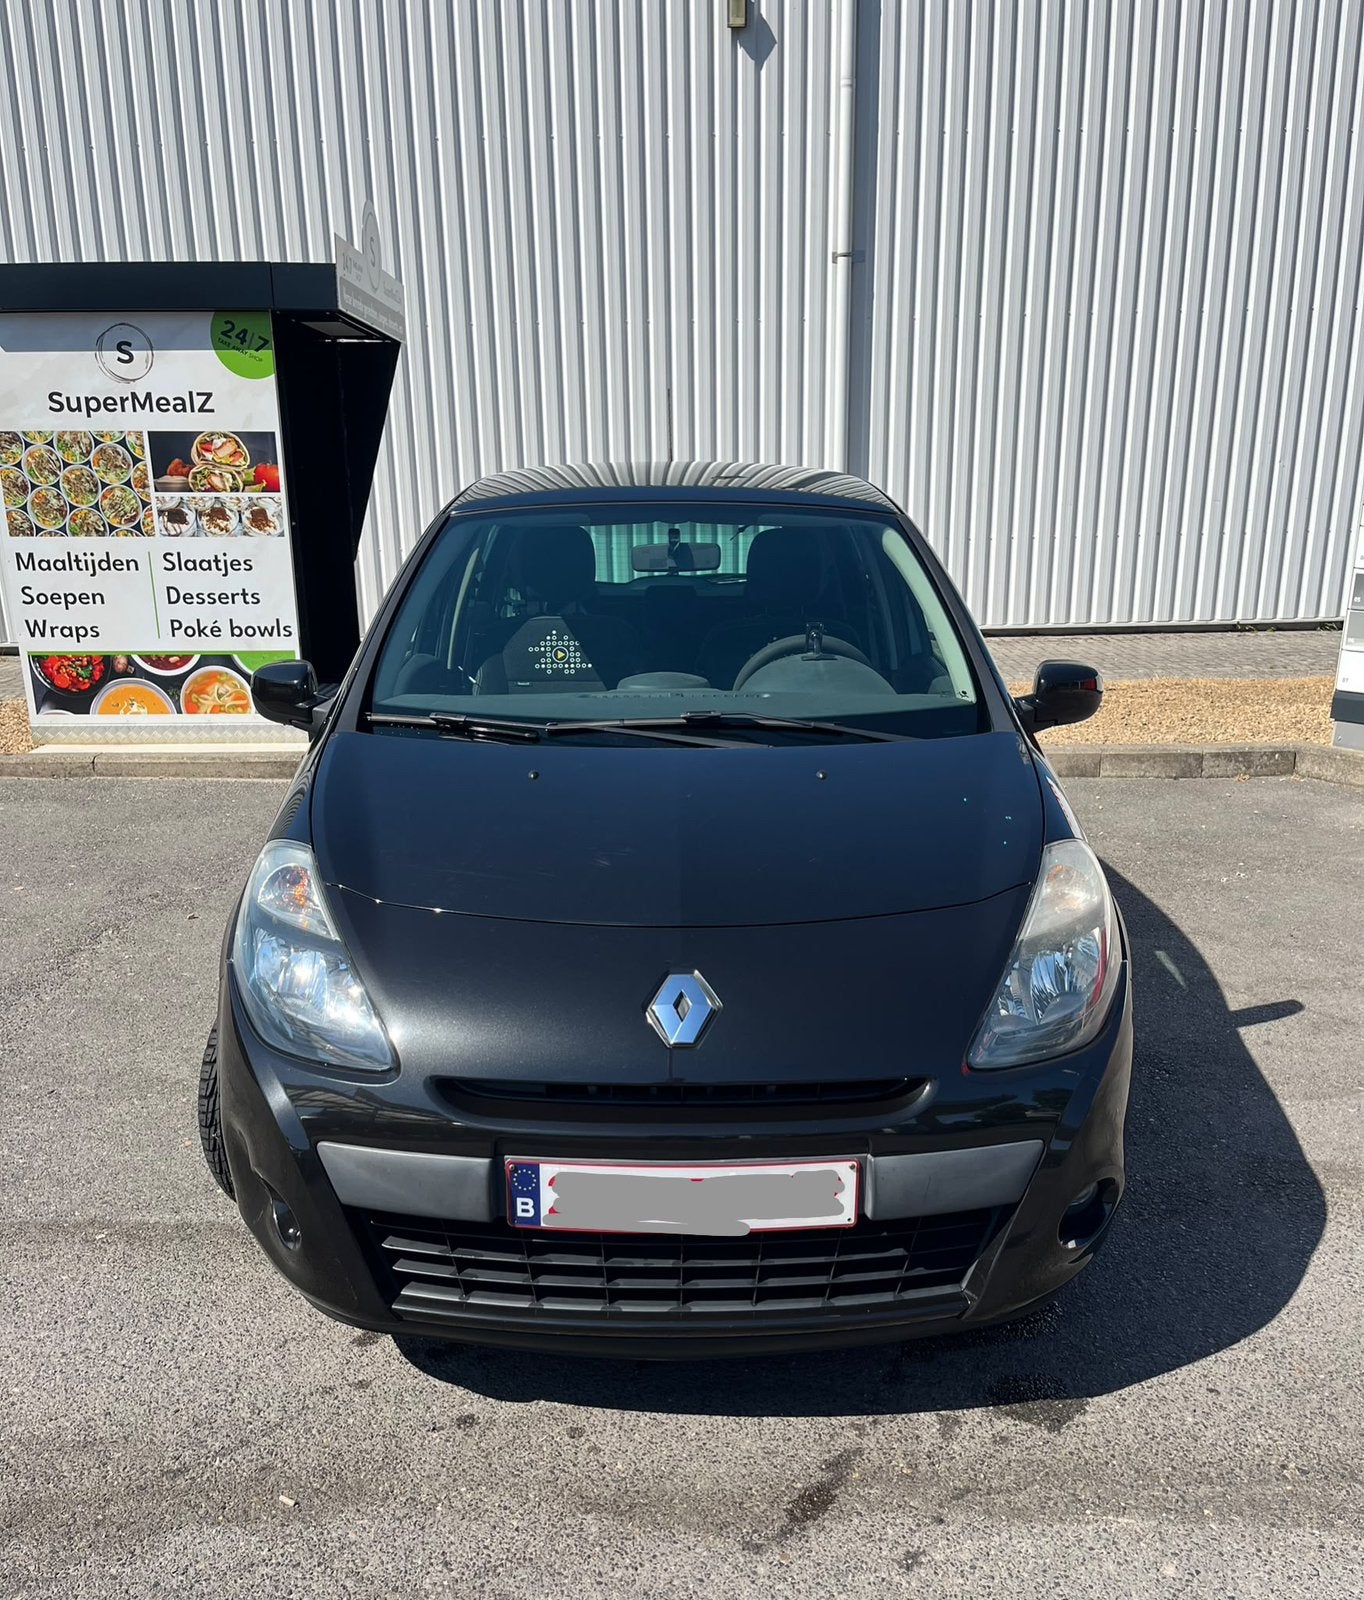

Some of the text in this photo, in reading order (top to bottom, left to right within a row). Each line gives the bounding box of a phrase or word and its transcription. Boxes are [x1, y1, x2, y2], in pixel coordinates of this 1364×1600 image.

[116, 341, 135, 364] S
[231, 345, 249, 356] AWAY
[47, 391, 215, 417] SuperMealZ
[15, 551, 140, 577] Maaltijden
[162, 551, 254, 576] Slaatjes
[21, 586, 105, 610] Soepen
[166, 586, 261, 606] Desserts
[25, 619, 100, 643] Wraps
[170, 618, 293, 638] Poké bowls
[516, 1197, 535, 1218] B
